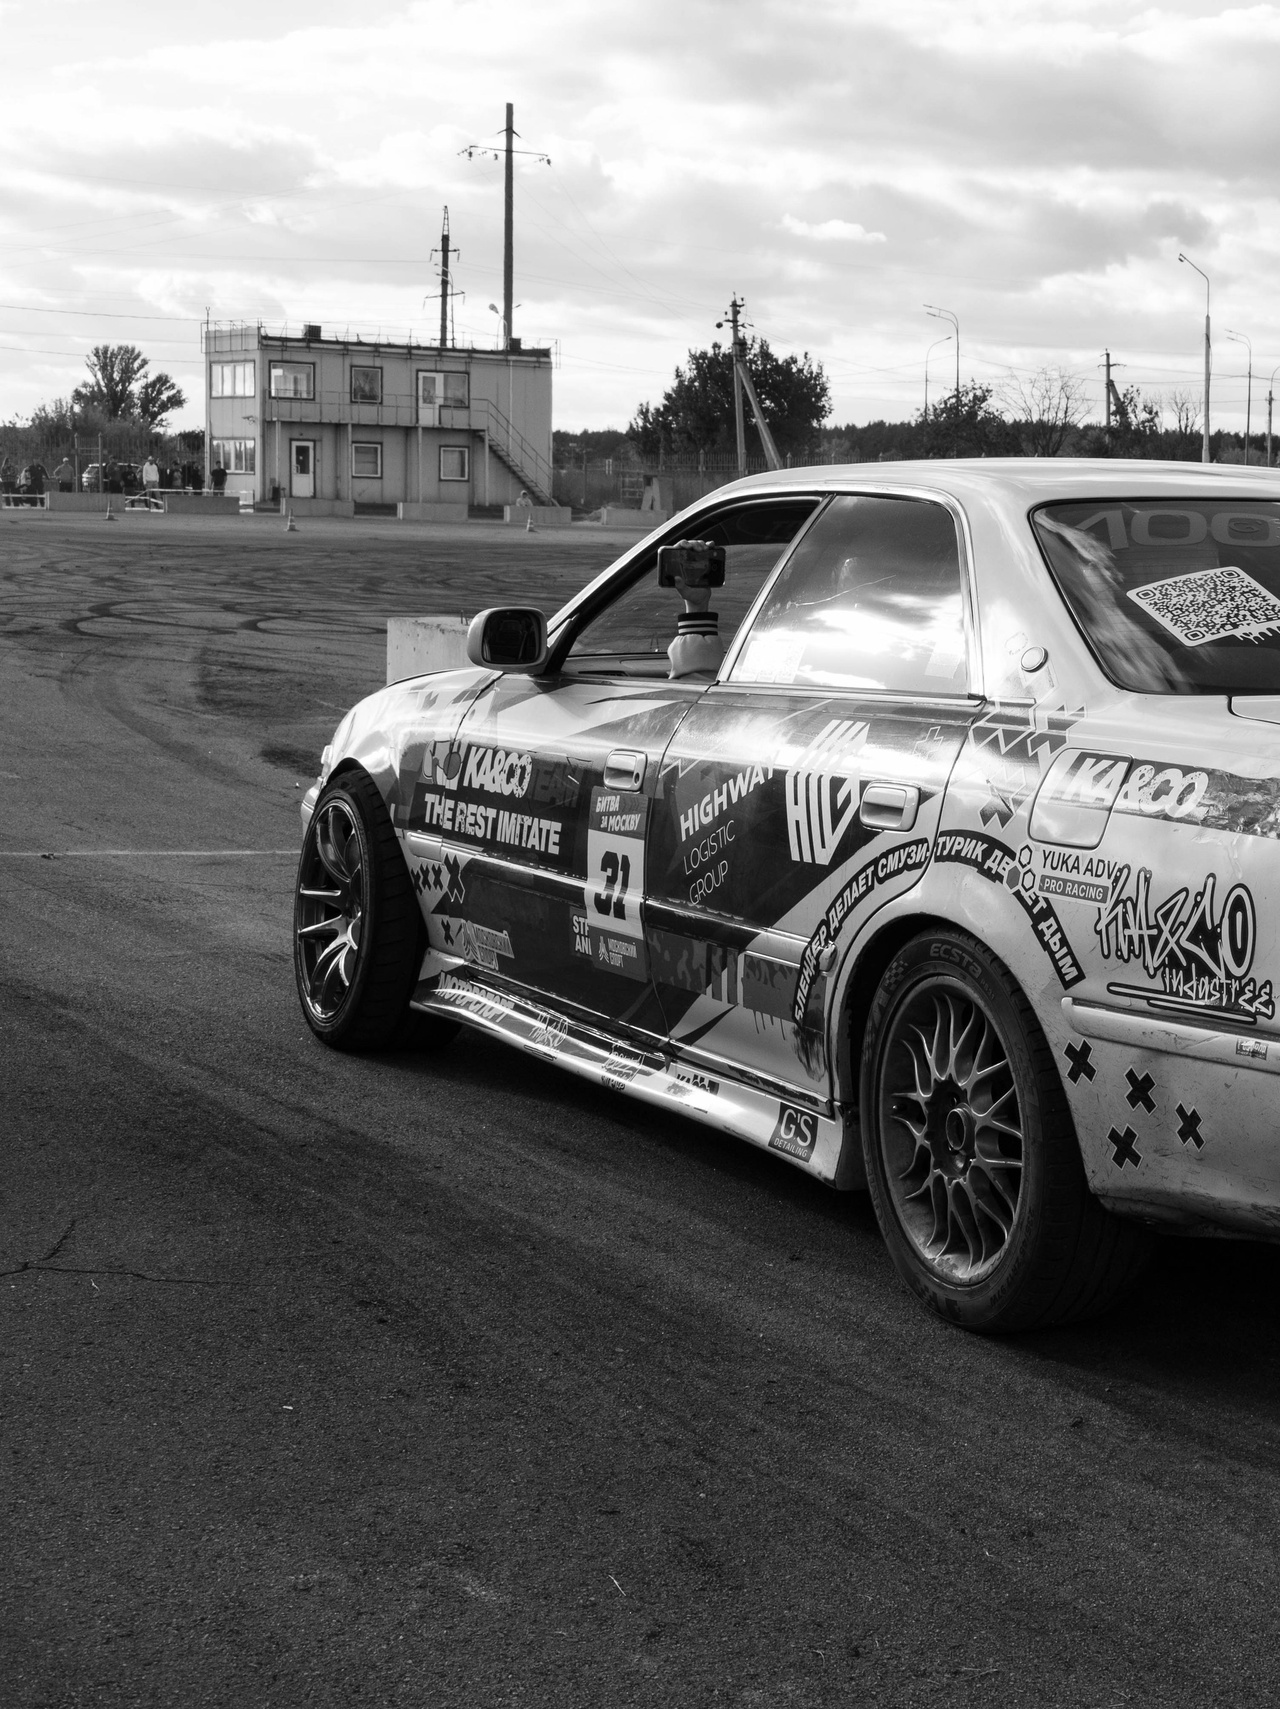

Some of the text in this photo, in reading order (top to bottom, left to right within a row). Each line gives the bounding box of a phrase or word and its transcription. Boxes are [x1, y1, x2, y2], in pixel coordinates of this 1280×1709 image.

[463, 746, 533, 799] KA&CO
[679, 750, 780, 842] HIGHWAY
[424, 793, 563, 855] THE REST IMITATE
[596, 795, 620, 813] БИТВА
[600, 813, 641, 832] ЗА МОСКВУ
[683, 820, 736, 875] LOGISTIC
[1042, 849, 1118, 880] YUKA ADV
[593, 850, 631, 921] 31
[689, 860, 729, 905] GROUP
[1043, 878, 1104, 901] PRO RACING
[828, 864, 875, 936] ДЕЛАЕТ
[936, 836, 989, 863] ТУРИК
[1037, 916, 1079, 982] ДЫМ
[434, 971, 515, 1023] МОТОРСПОРТ
[773, 1137, 809, 1158] DETAILING
[780, 1108, 814, 1147] G'S
